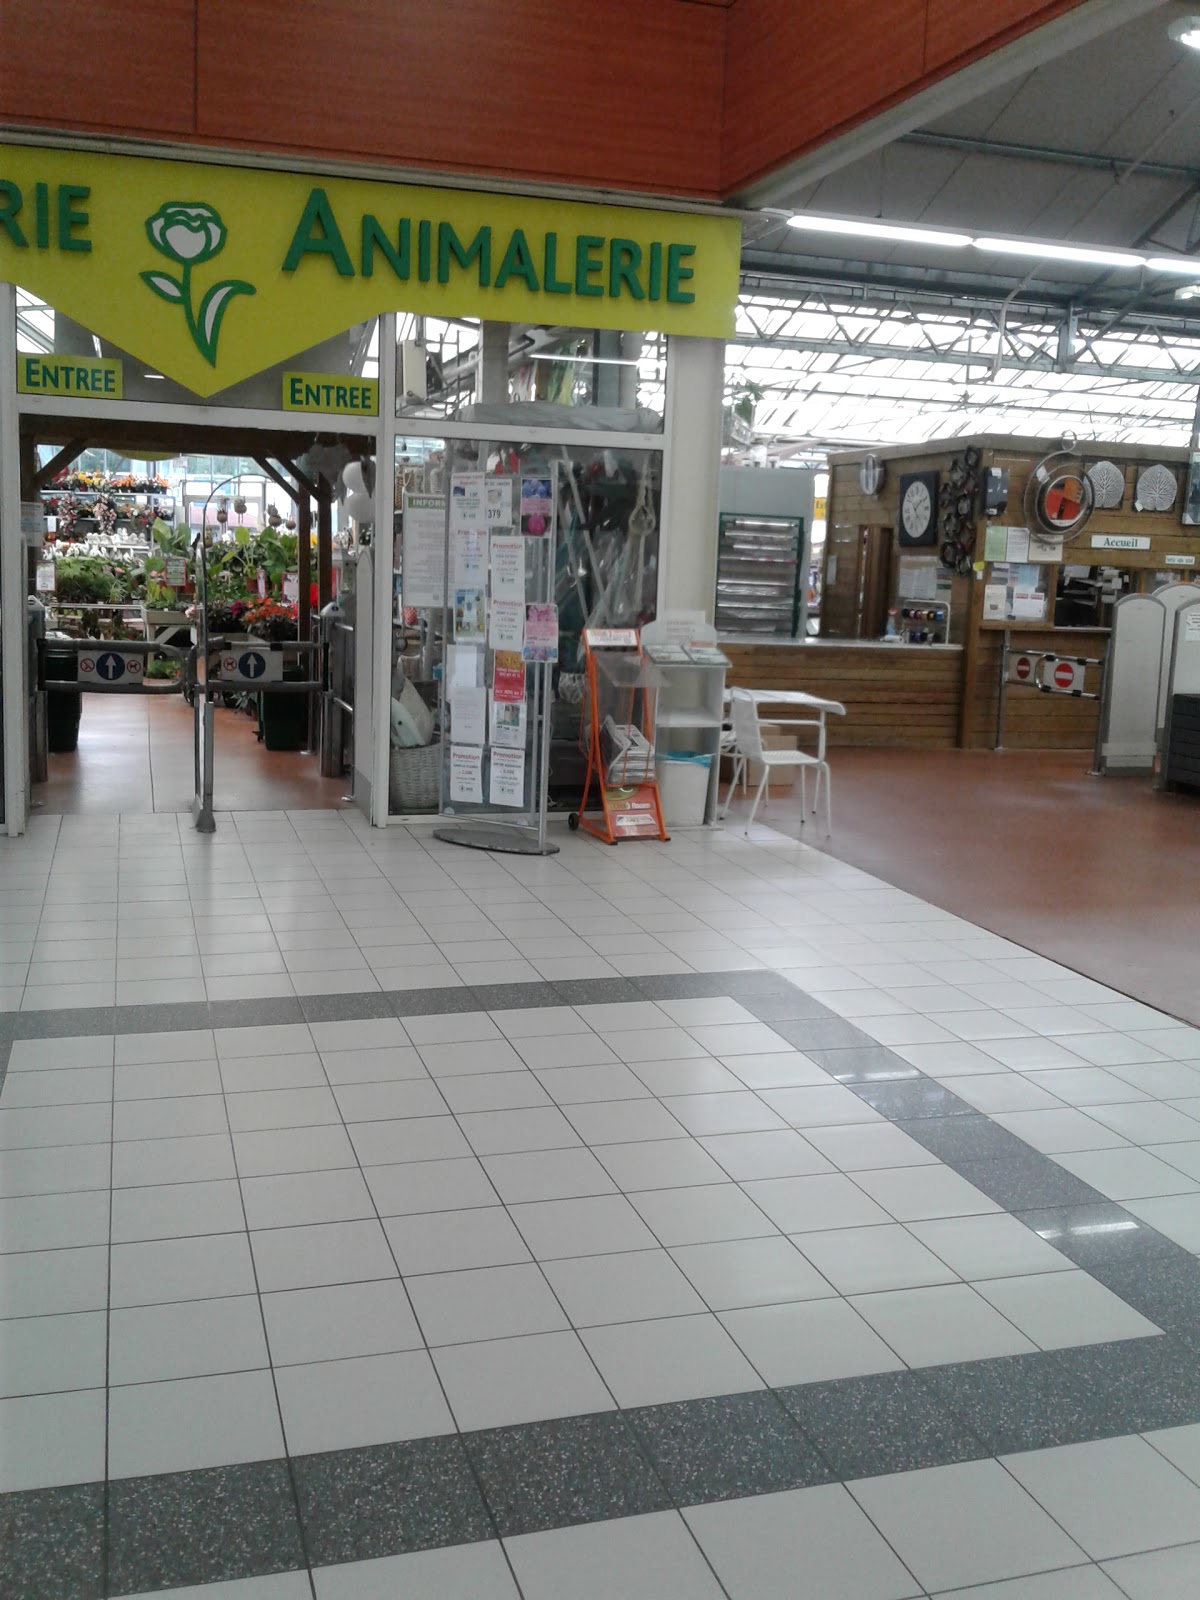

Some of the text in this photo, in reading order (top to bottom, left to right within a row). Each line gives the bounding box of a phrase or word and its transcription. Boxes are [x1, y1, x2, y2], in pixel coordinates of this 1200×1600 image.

[282, 188, 696, 303] ANIMALERIE
[25, 358, 116, 393] ENTREE
[290, 378, 372, 410] ENTREE
[1103, 538, 1138, 548] Accueil
[493, 599, 523, 607] Promotion
[452, 752, 480, 760] Promotion
[492, 751, 523, 760] Promotion
